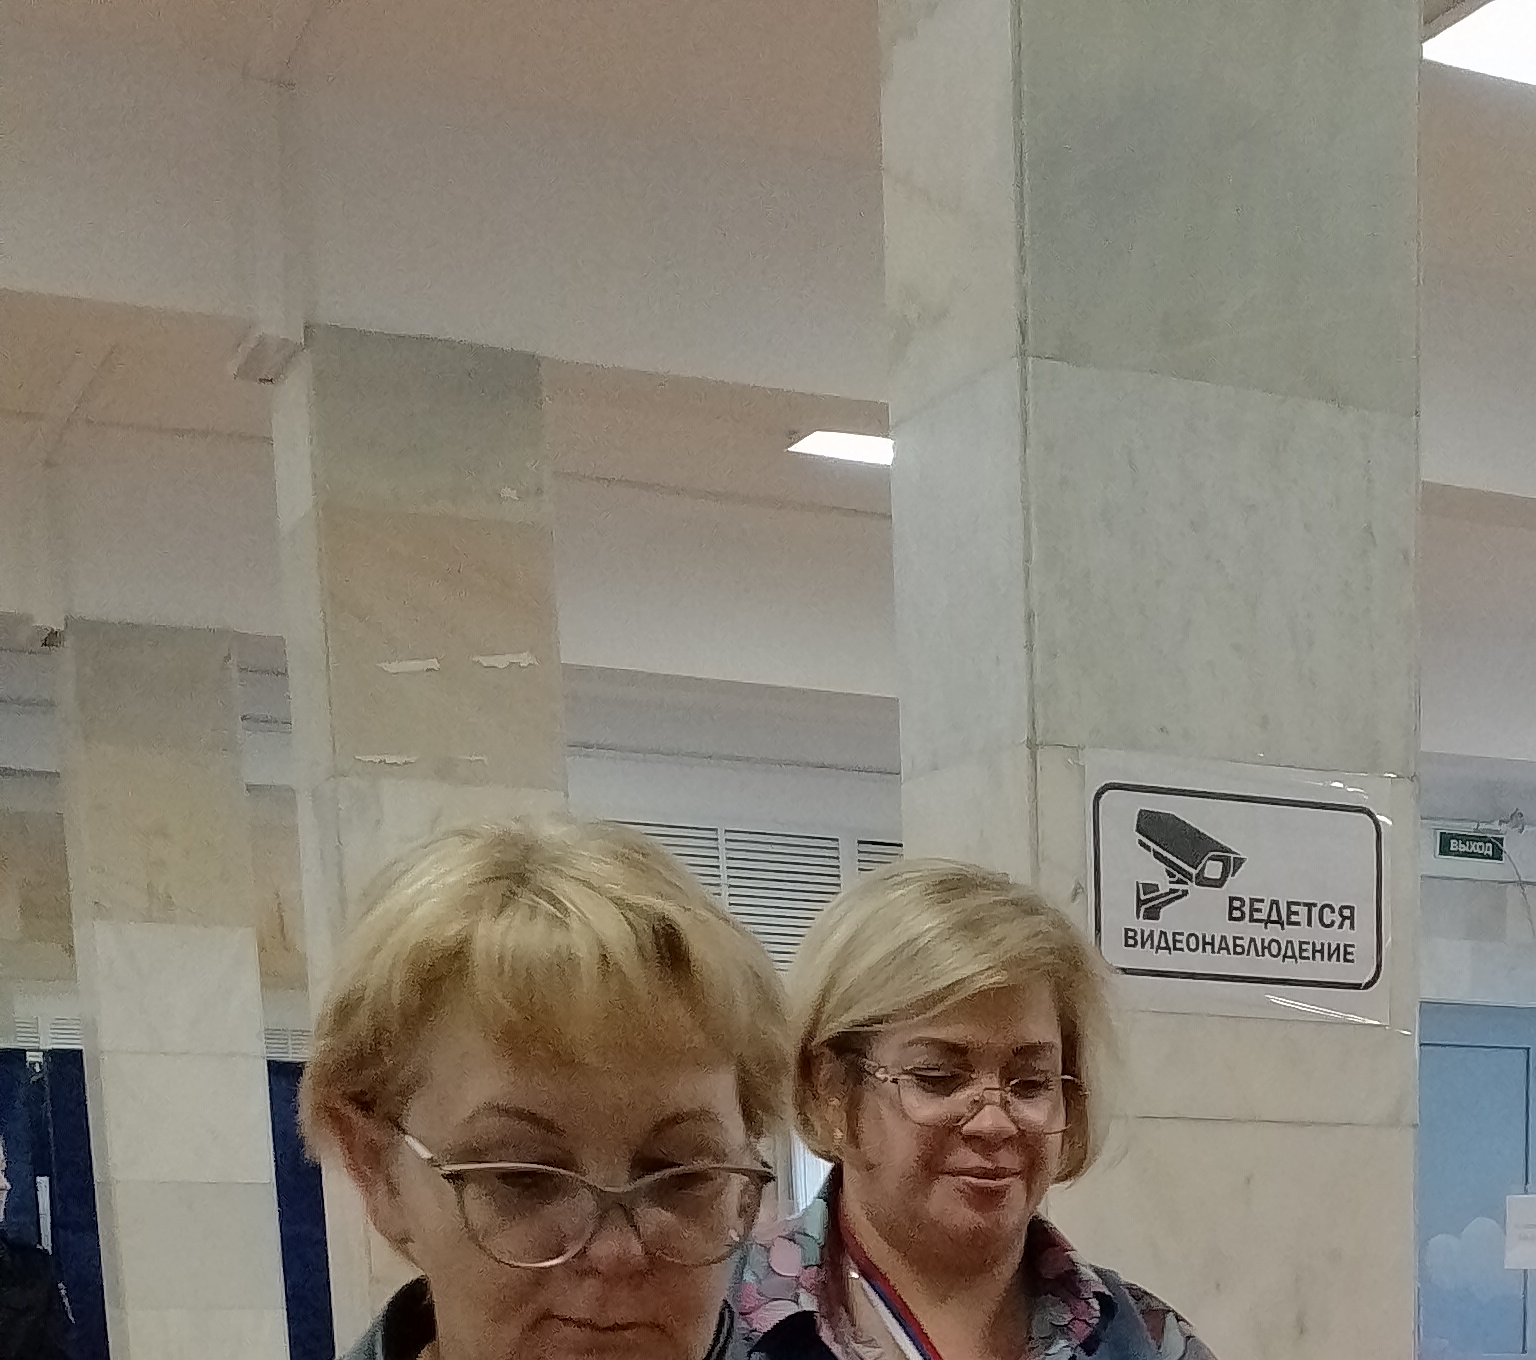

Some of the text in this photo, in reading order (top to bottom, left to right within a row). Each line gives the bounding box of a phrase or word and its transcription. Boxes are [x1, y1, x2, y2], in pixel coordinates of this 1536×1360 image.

[1450, 839, 1492, 857] ВЫХОД
[1227, 895, 1356, 931] ВЕДЕТСЯ
[1123, 927, 1356, 964] ВИДЕОНАБЛЮДЕНИЕ
